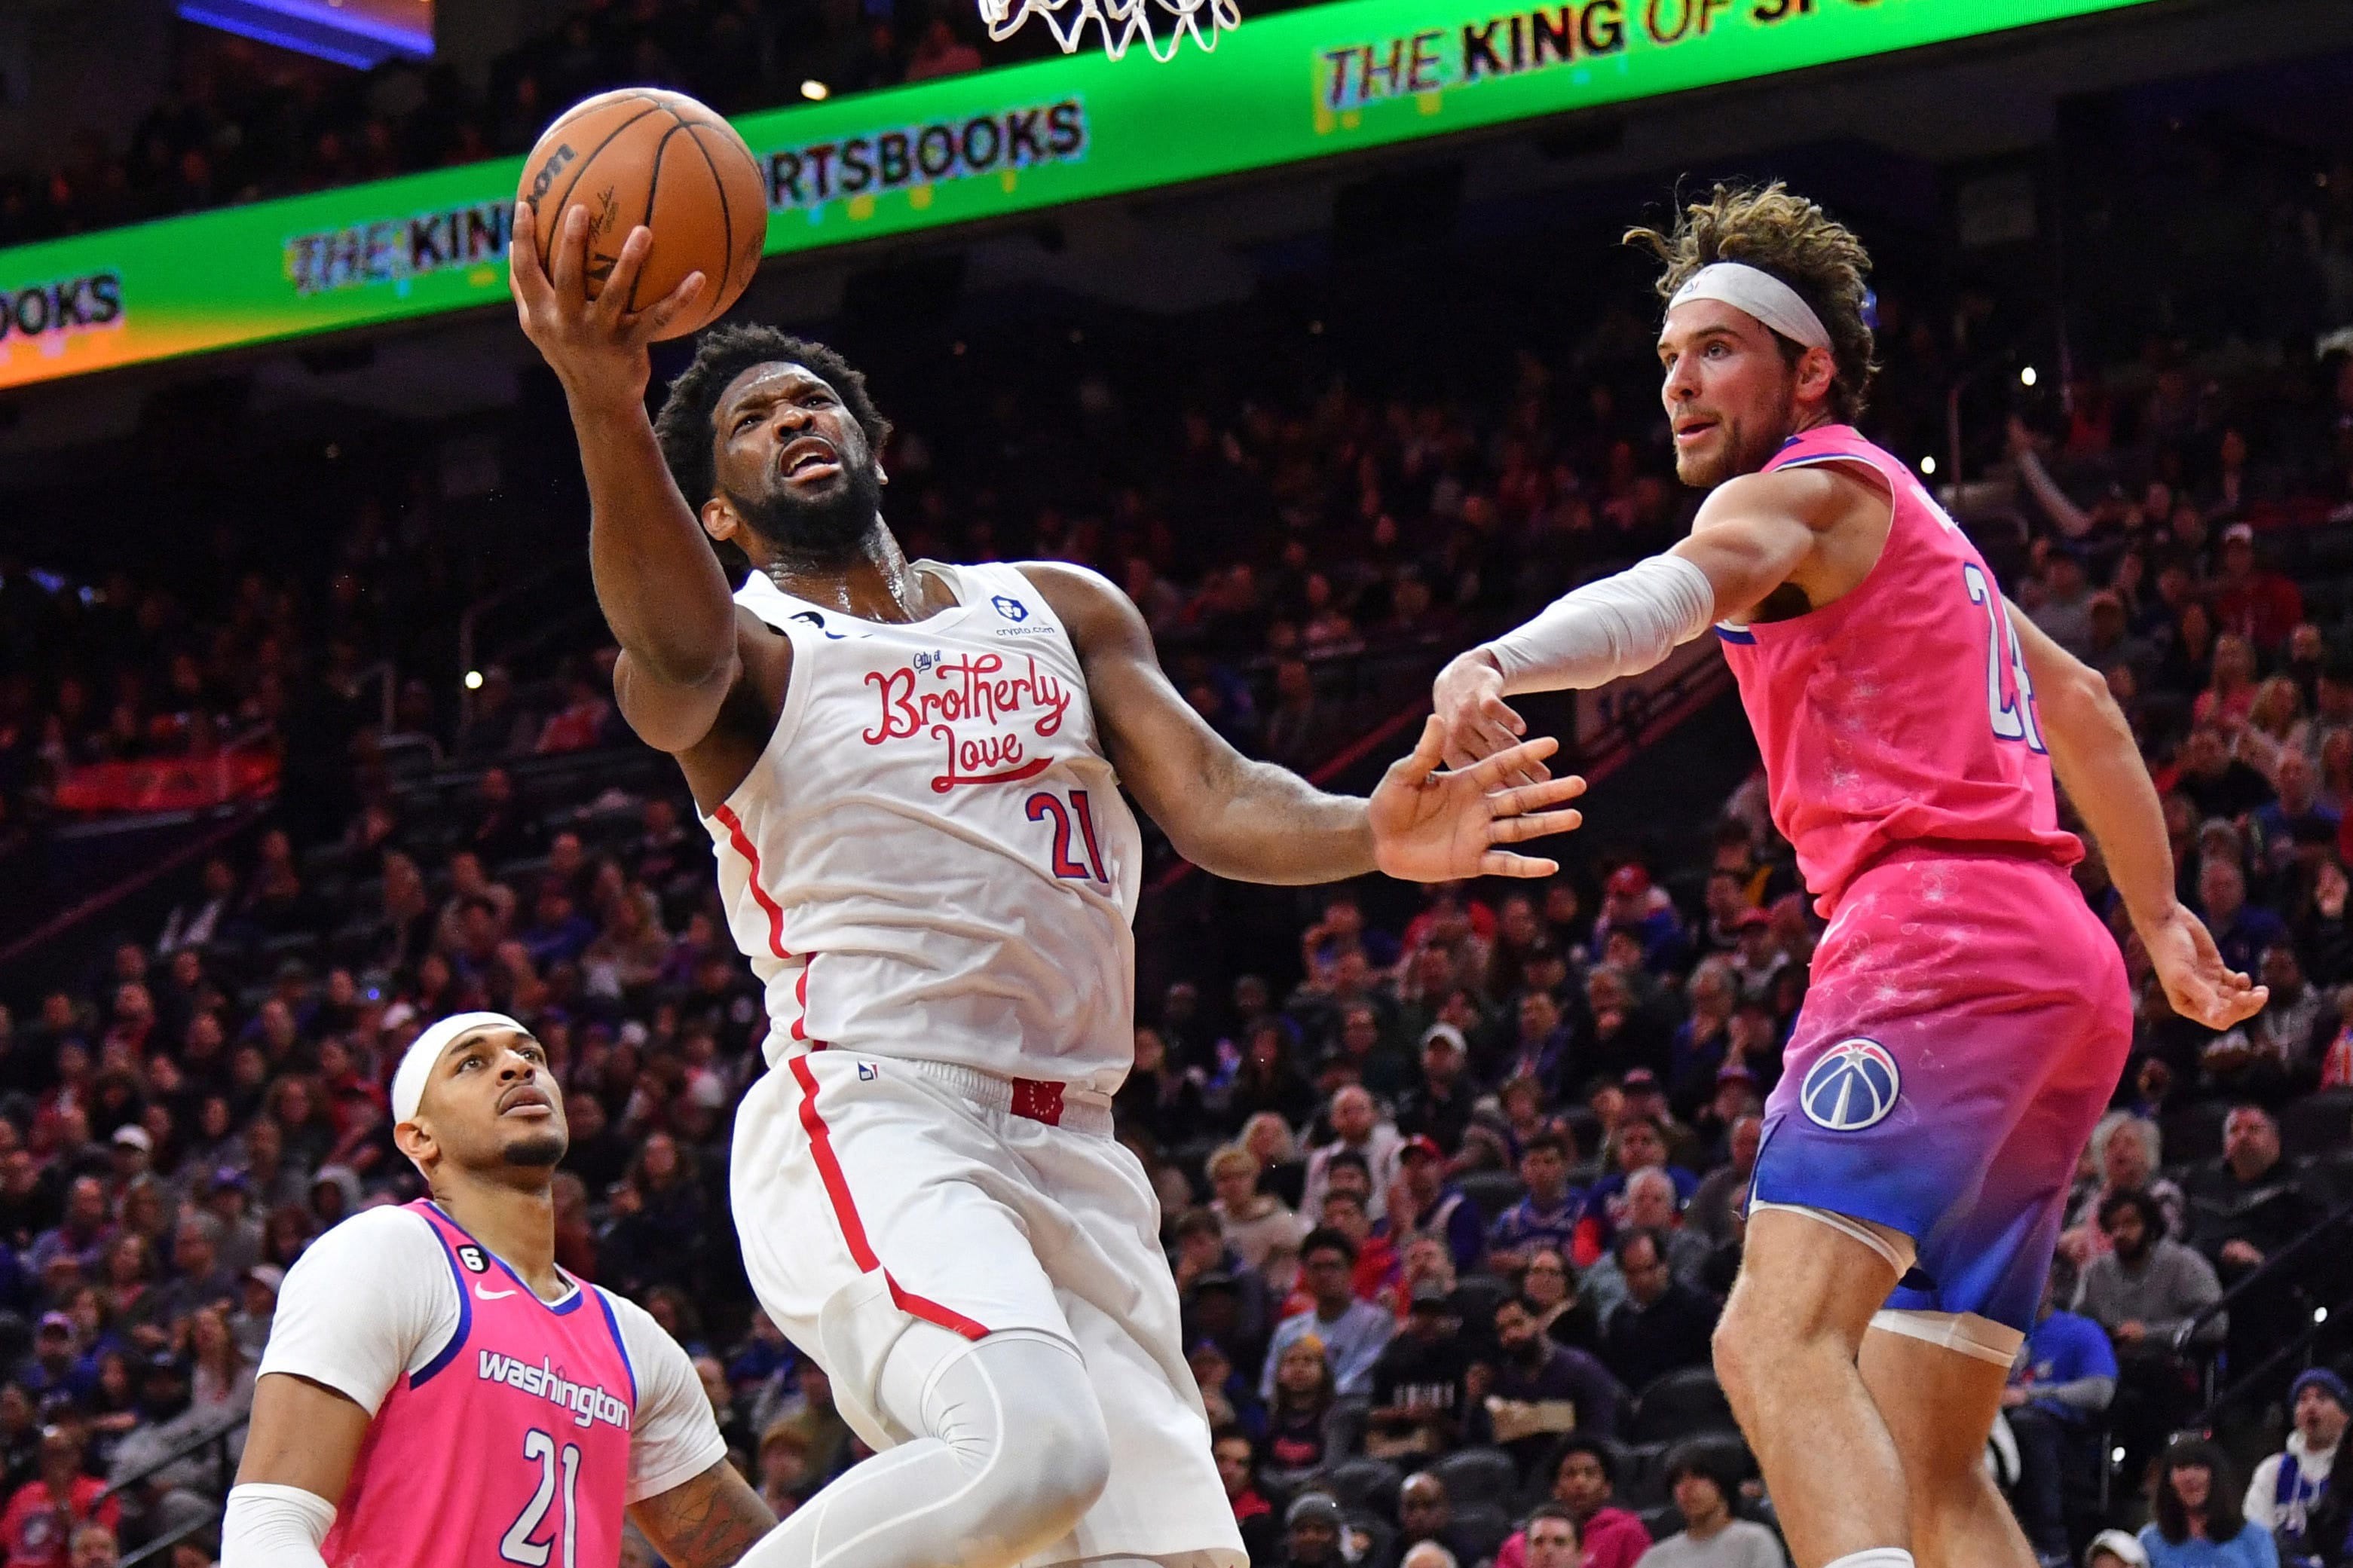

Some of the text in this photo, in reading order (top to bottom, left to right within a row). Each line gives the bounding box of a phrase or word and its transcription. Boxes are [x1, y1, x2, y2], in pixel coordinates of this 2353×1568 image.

[1324, 30, 1445, 107] THE
[1464, 0, 1625, 80] KING
[289, 223, 396, 292] THE
[408, 201, 516, 270] KIN
[760, 100, 1084, 206] RTSBOOKS
[0, 274, 118, 339] OKS
[862, 653, 1071, 745] Brotherly
[1963, 561, 2049, 754] 24
[931, 724, 1055, 793] Love
[1025, 790, 1109, 884] 21
[460, 1247, 485, 1272] 6
[498, 1427, 582, 1568] 21
